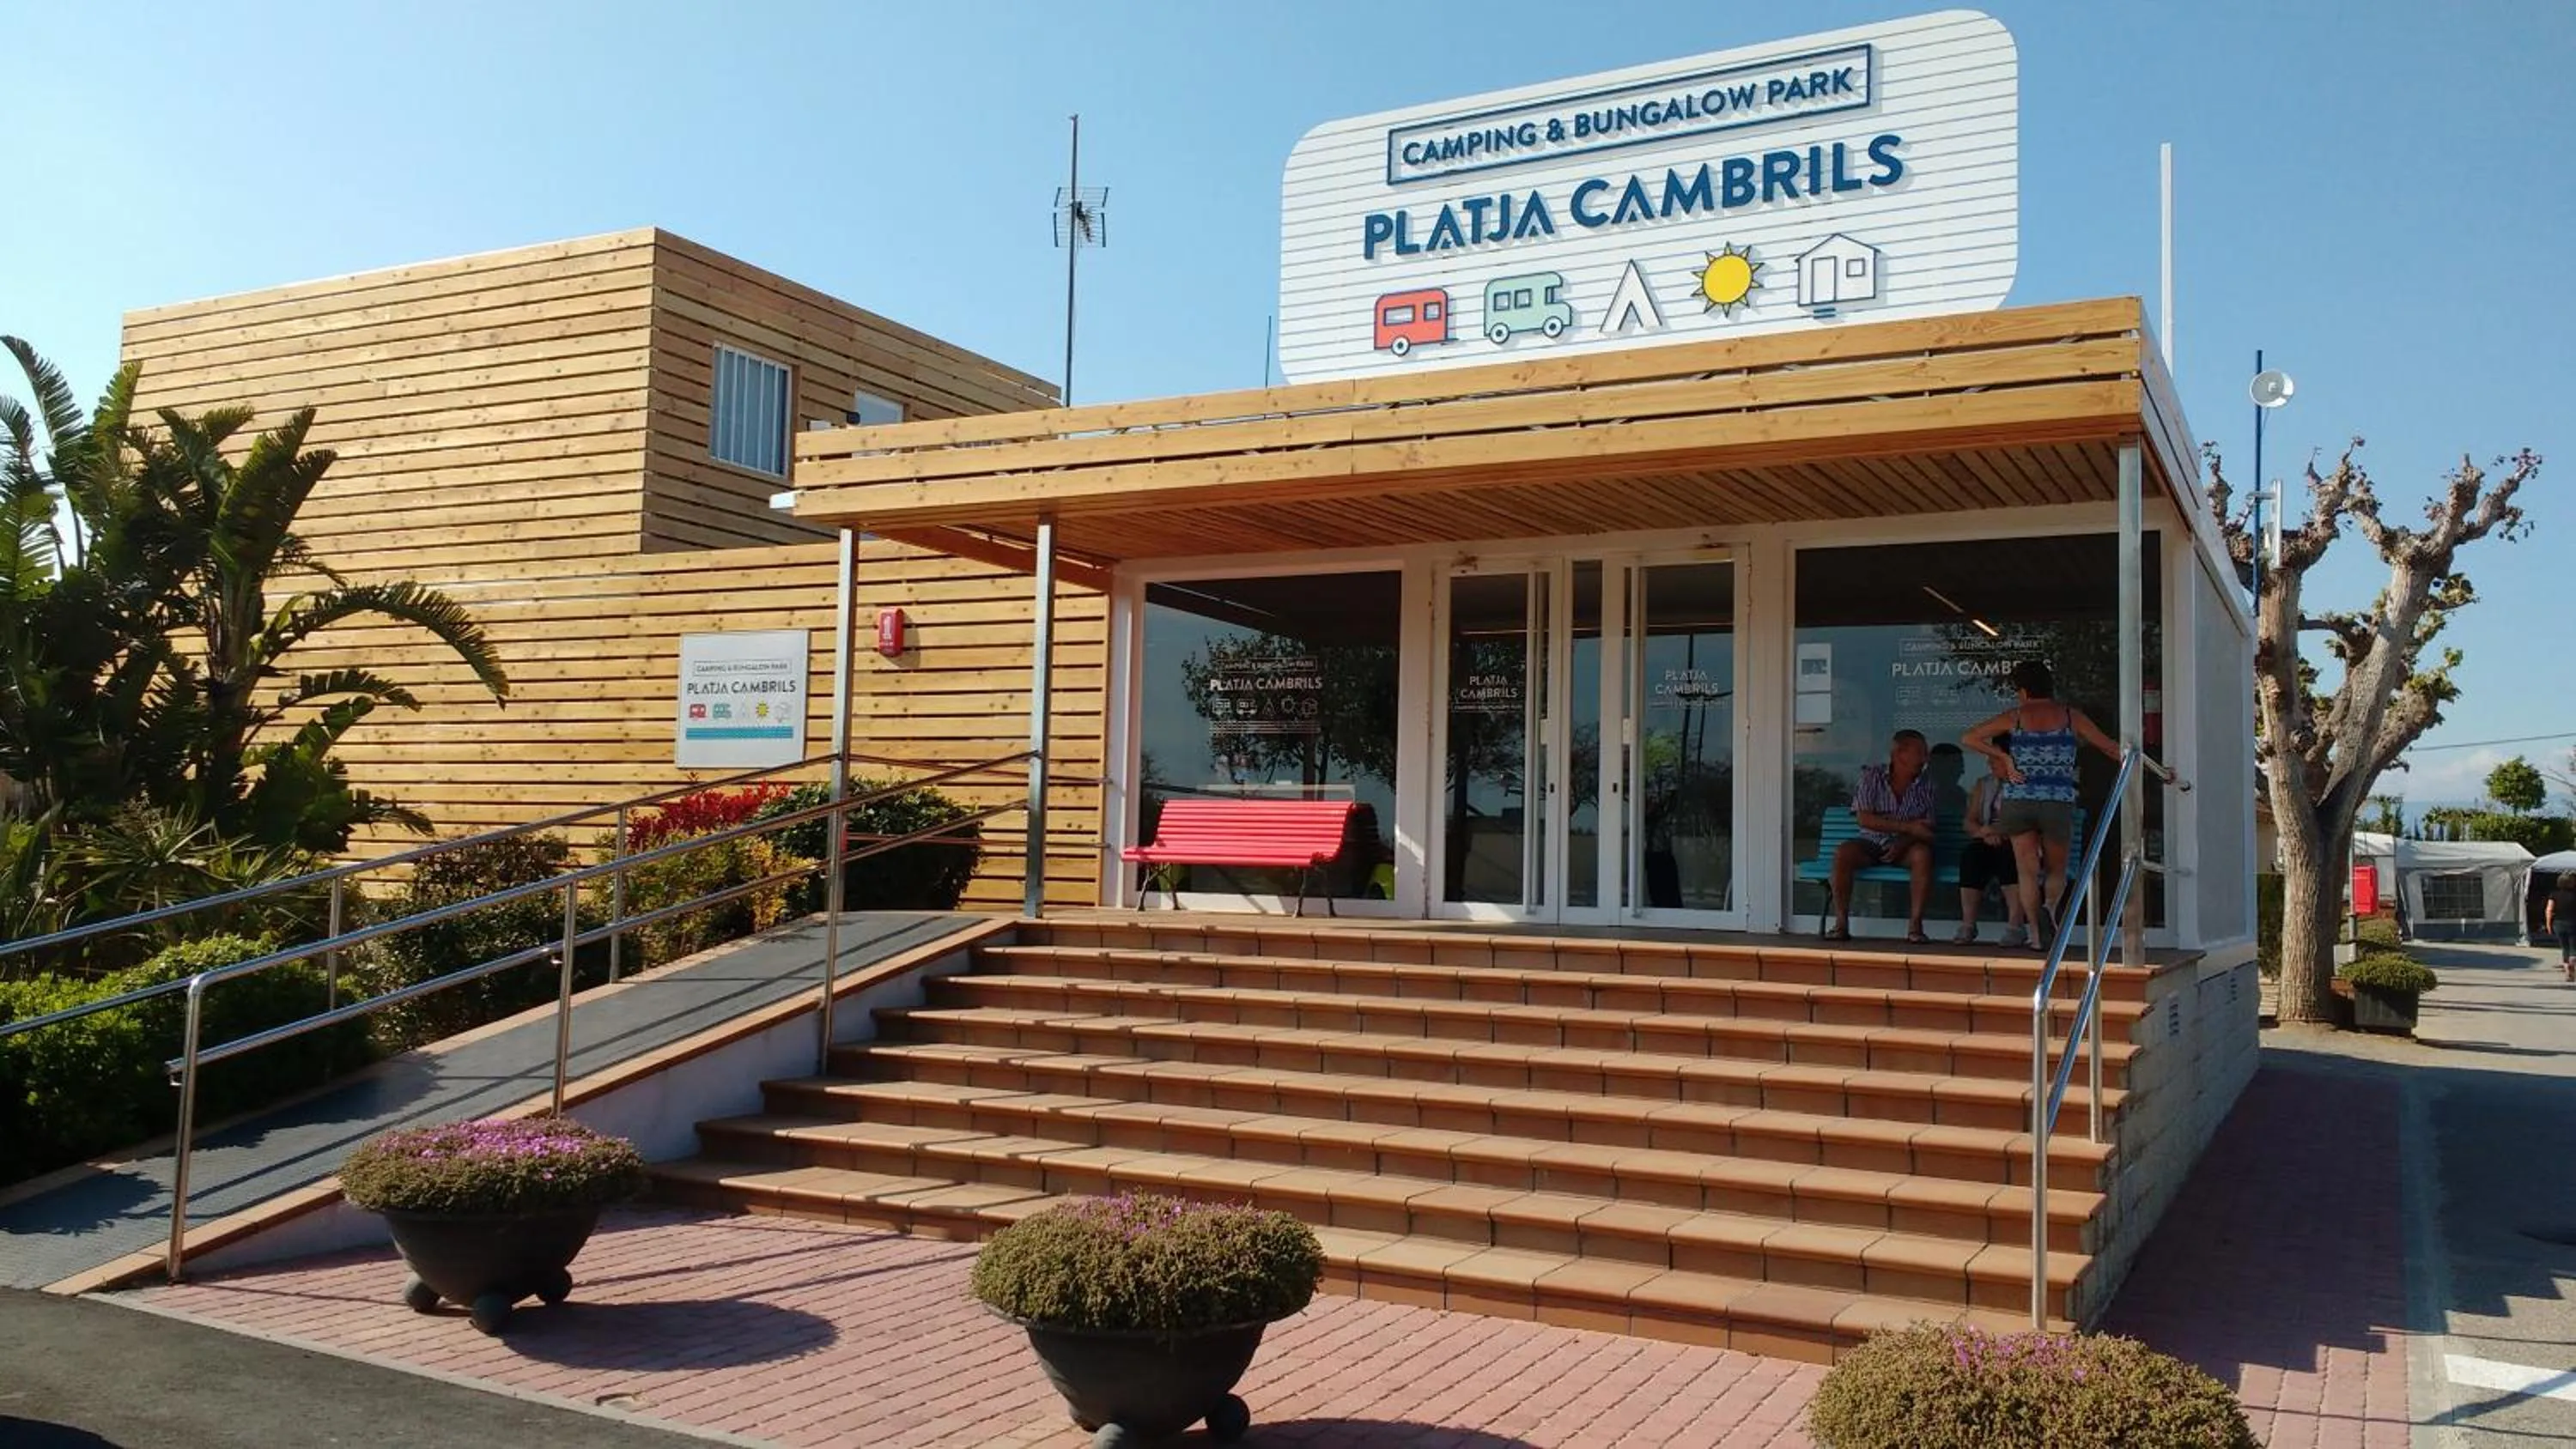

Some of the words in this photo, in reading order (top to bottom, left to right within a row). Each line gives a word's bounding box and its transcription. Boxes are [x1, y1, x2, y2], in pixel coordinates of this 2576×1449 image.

[1402, 122, 1537, 166] CAMPING
[1546, 118, 1565, 142] &
[1574, 83, 1757, 138] BUNGALOW
[1767, 67, 1853, 105] PARK
[1364, 190, 1555, 260] PLATJA
[1571, 134, 1904, 227] CAMBRILS
[1665, 670, 1708, 681] PLATJA
[1892, 661, 1953, 677] PLATJA
[1957, 659, 2053, 676] CAMBS
[686, 681, 729, 695] PLATJA
[731, 679, 797, 694] CAMBRILS
[1209, 678, 1253, 691] PLATJA
[1255, 676, 1323, 690] CAMBRILS
[1469, 675, 1509, 686] PLATJA
[1655, 682, 1718, 694] CAMBRILS
[1460, 687, 1518, 700] CAMBRILS
